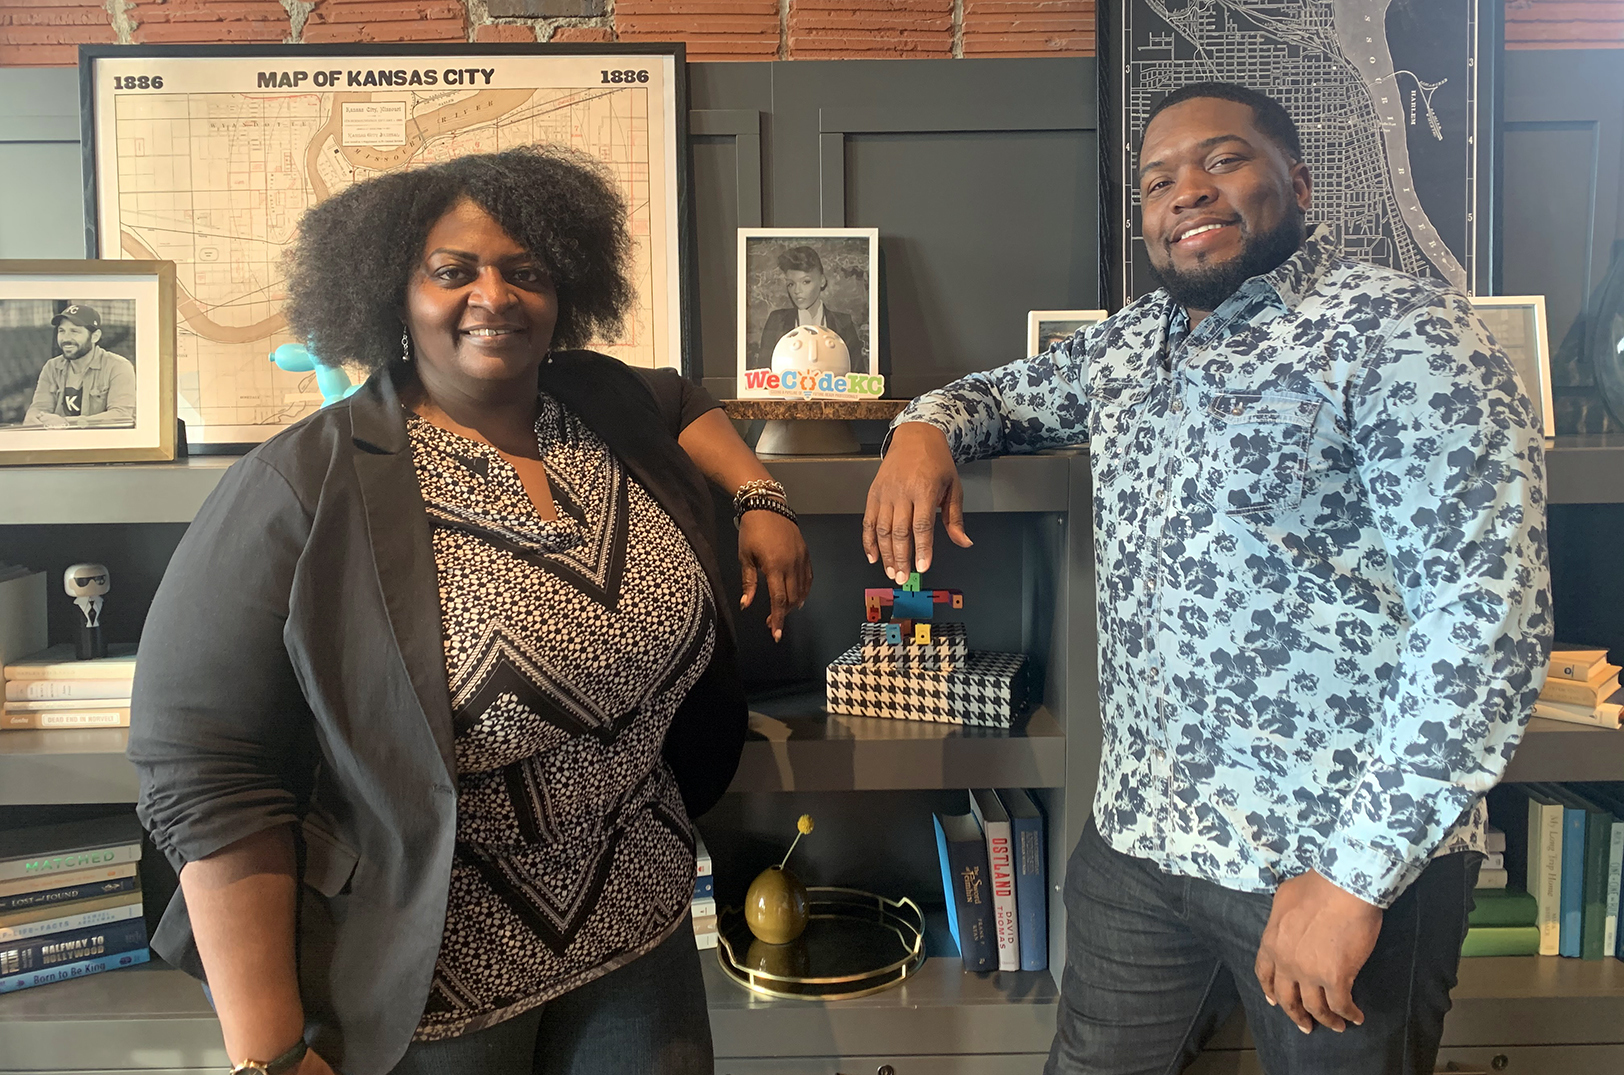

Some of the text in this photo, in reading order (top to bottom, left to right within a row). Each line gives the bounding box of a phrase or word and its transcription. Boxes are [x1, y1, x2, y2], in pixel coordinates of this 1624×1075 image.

[113, 75, 164, 90] 1886
[257, 68, 496, 88] MAP OF KANSAS CITY
[601, 69, 650, 84] 1886
[65, 395, 80, 411] K
[26, 851, 115, 873] MATCHED
[1546, 815, 1559, 897] My Long Trip Home
[992, 837, 1012, 897] OSTLAND
[12, 896, 34, 907] LOST
[46, 890, 79, 901] FOUND
[972, 879, 983, 905] Sword
[997, 906, 1006, 950] THOMAS
[1005, 911, 1014, 944] DAVID
[42, 935, 104, 956] HALFWAY TO
[43, 945, 104, 965] HOLLYWOOD
[33, 963, 106, 985] Born to Be King
